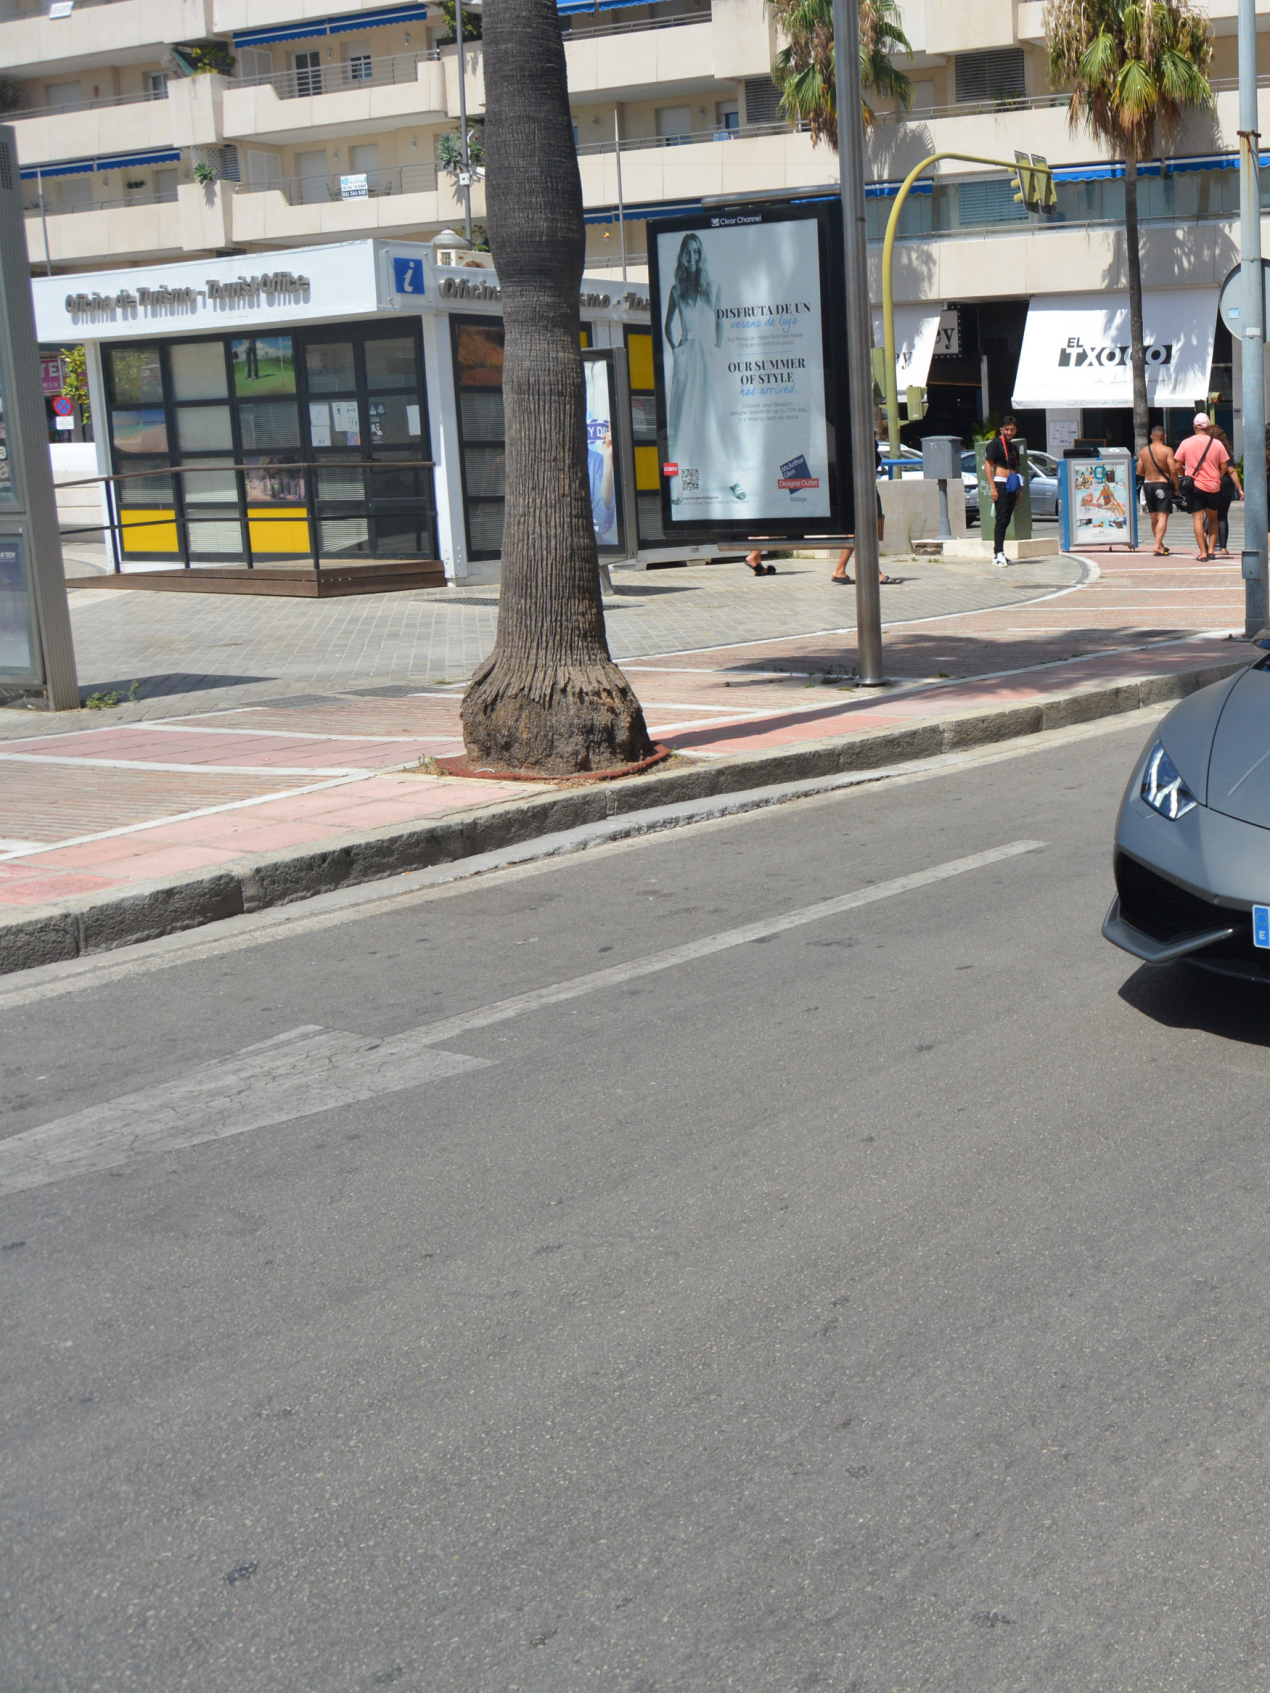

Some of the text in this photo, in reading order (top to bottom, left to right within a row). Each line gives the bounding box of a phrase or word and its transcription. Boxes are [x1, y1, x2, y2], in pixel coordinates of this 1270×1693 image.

[720, 214, 762, 226] Clear Channel
[66, 291, 116, 313] Oficina
[116, 289, 137, 308] de
[137, 285, 196, 306] Turismo
[206, 275, 259, 299] Tourist
[259, 271, 310, 294] Office
[716, 302, 811, 320] DISFRUTA DE UN
[730, 314, 798, 333] verano de lujo
[1066, 337, 1084, 348] EL
[728, 358, 806, 373] OUR SUMMER
[740, 372, 794, 386] OF STYLE
[740, 382, 796, 396] has arrived
[782, 457, 804, 472] McArthur
[784, 468, 796, 479] Glen
[780, 478, 818, 488] Designer Outlet
[1258, 930, 1266, 940] E
